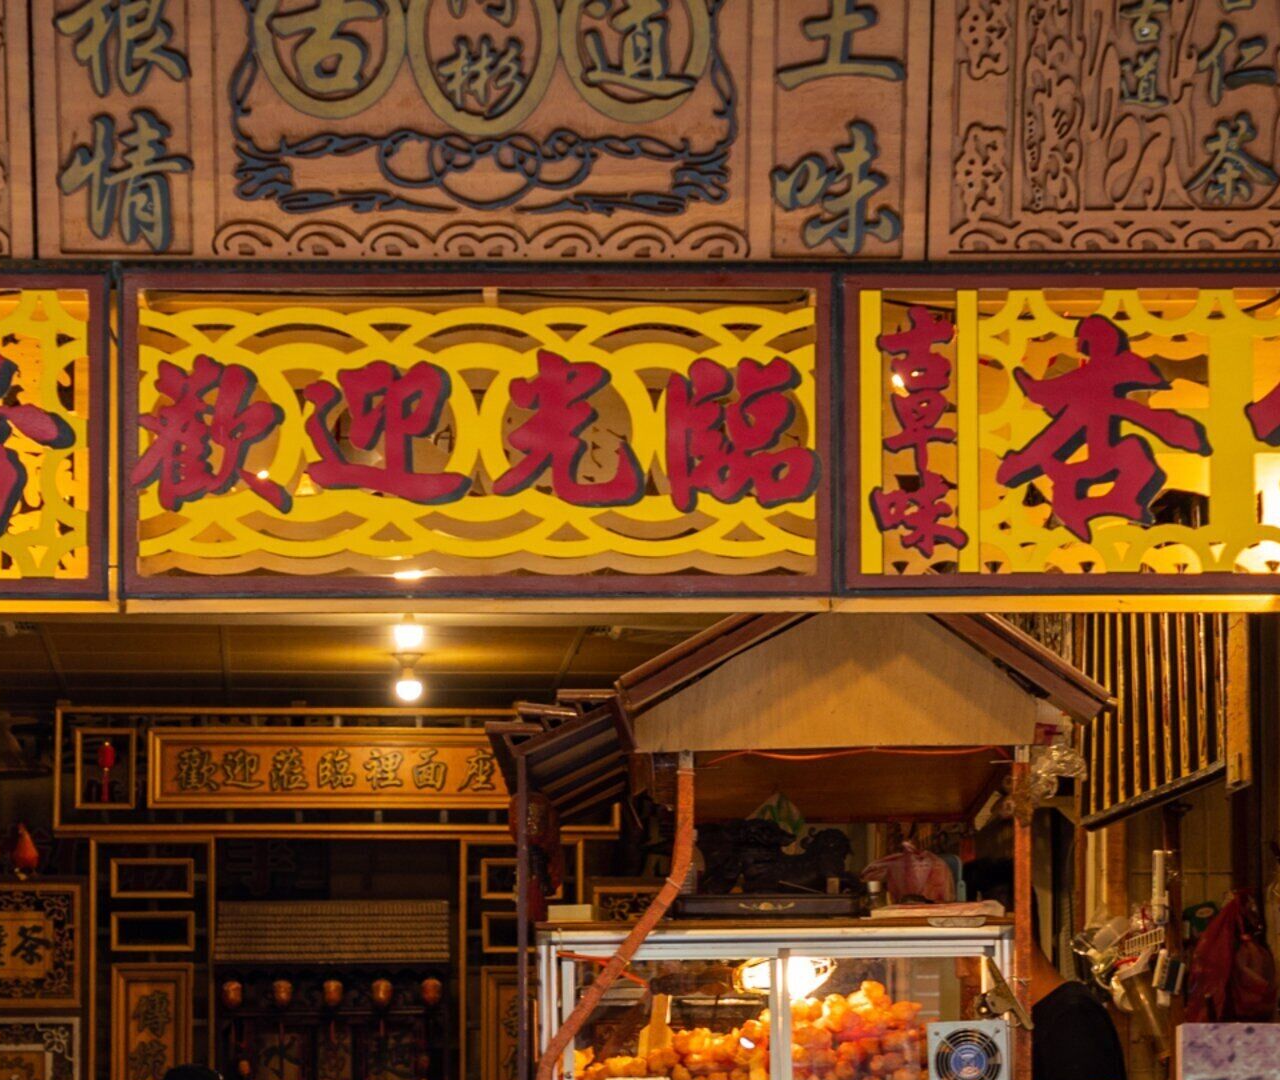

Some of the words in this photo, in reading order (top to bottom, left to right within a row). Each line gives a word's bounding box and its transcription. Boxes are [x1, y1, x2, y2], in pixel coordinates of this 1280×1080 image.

[131, 350, 823, 513] 歡迎光臨
[870, 304, 969, 559] 古早味
